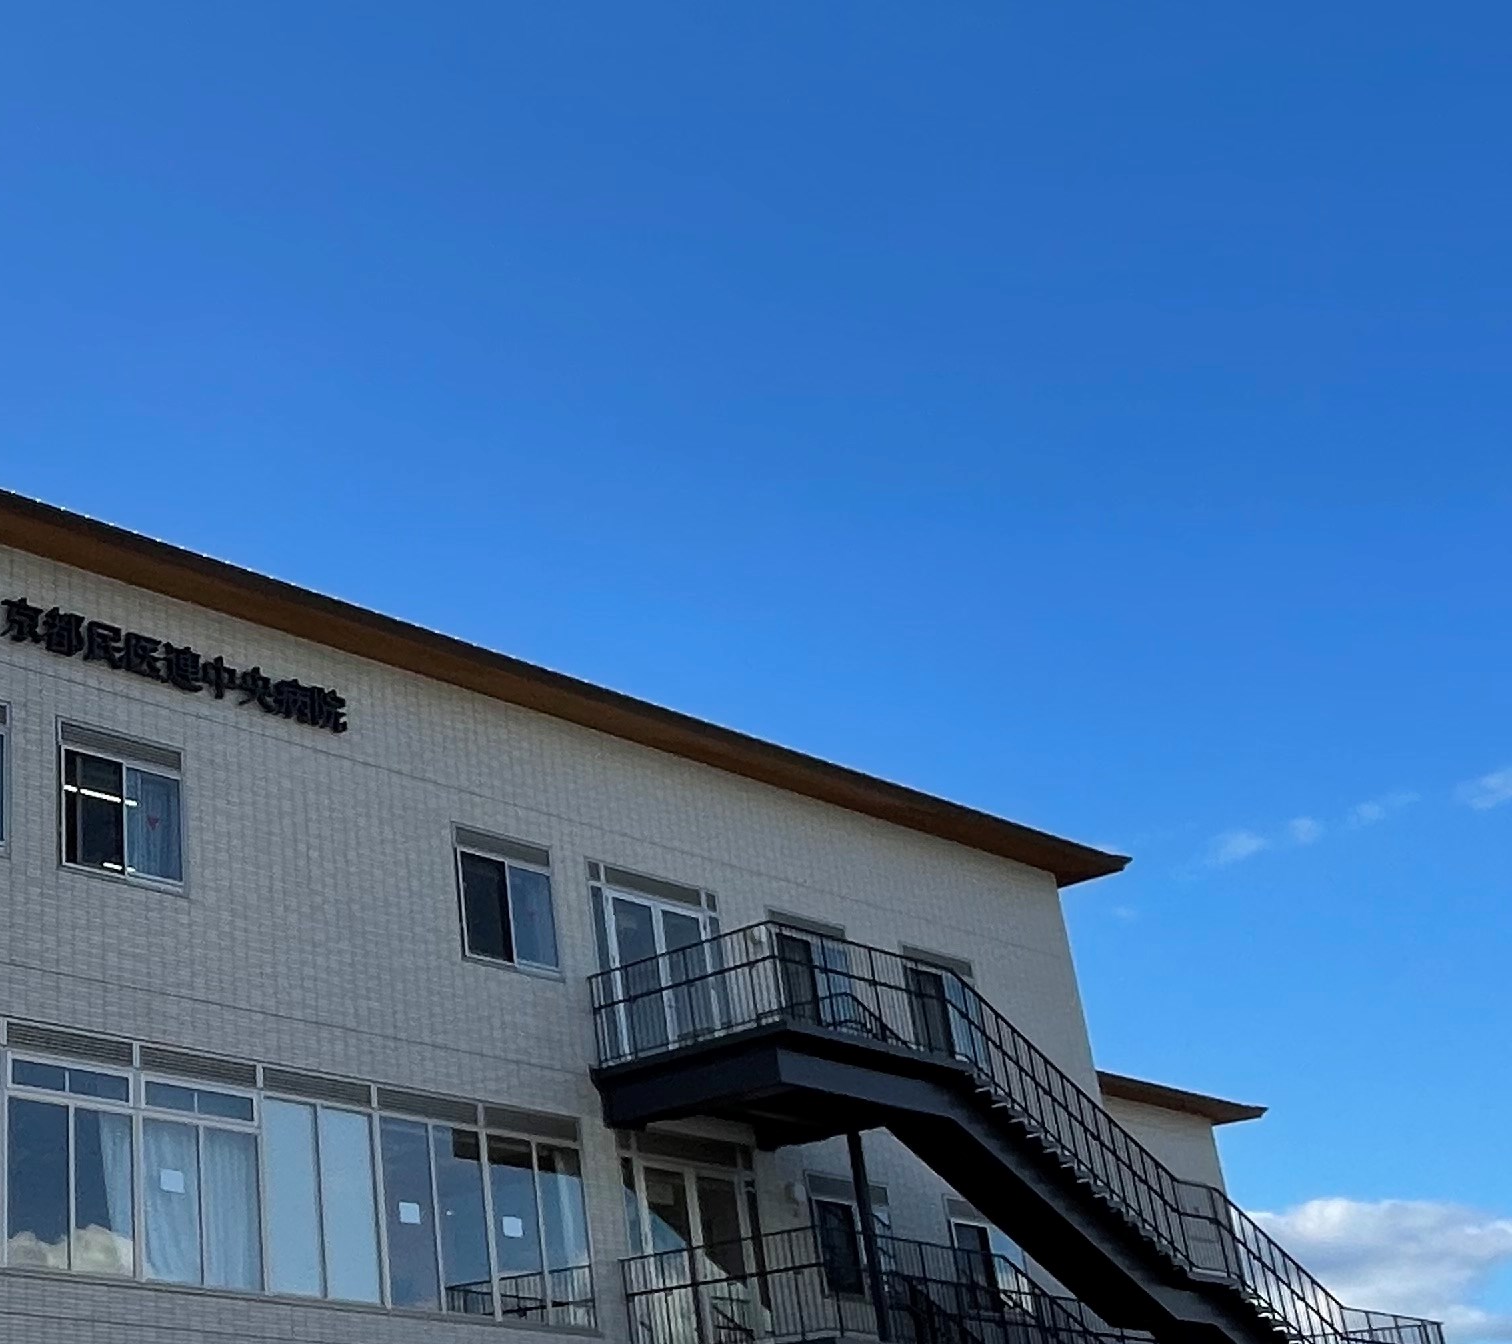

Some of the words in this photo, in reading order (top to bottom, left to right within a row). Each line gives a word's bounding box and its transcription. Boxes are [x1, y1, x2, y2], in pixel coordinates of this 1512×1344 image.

[0, 596, 348, 733] 京都民医連中央病院
